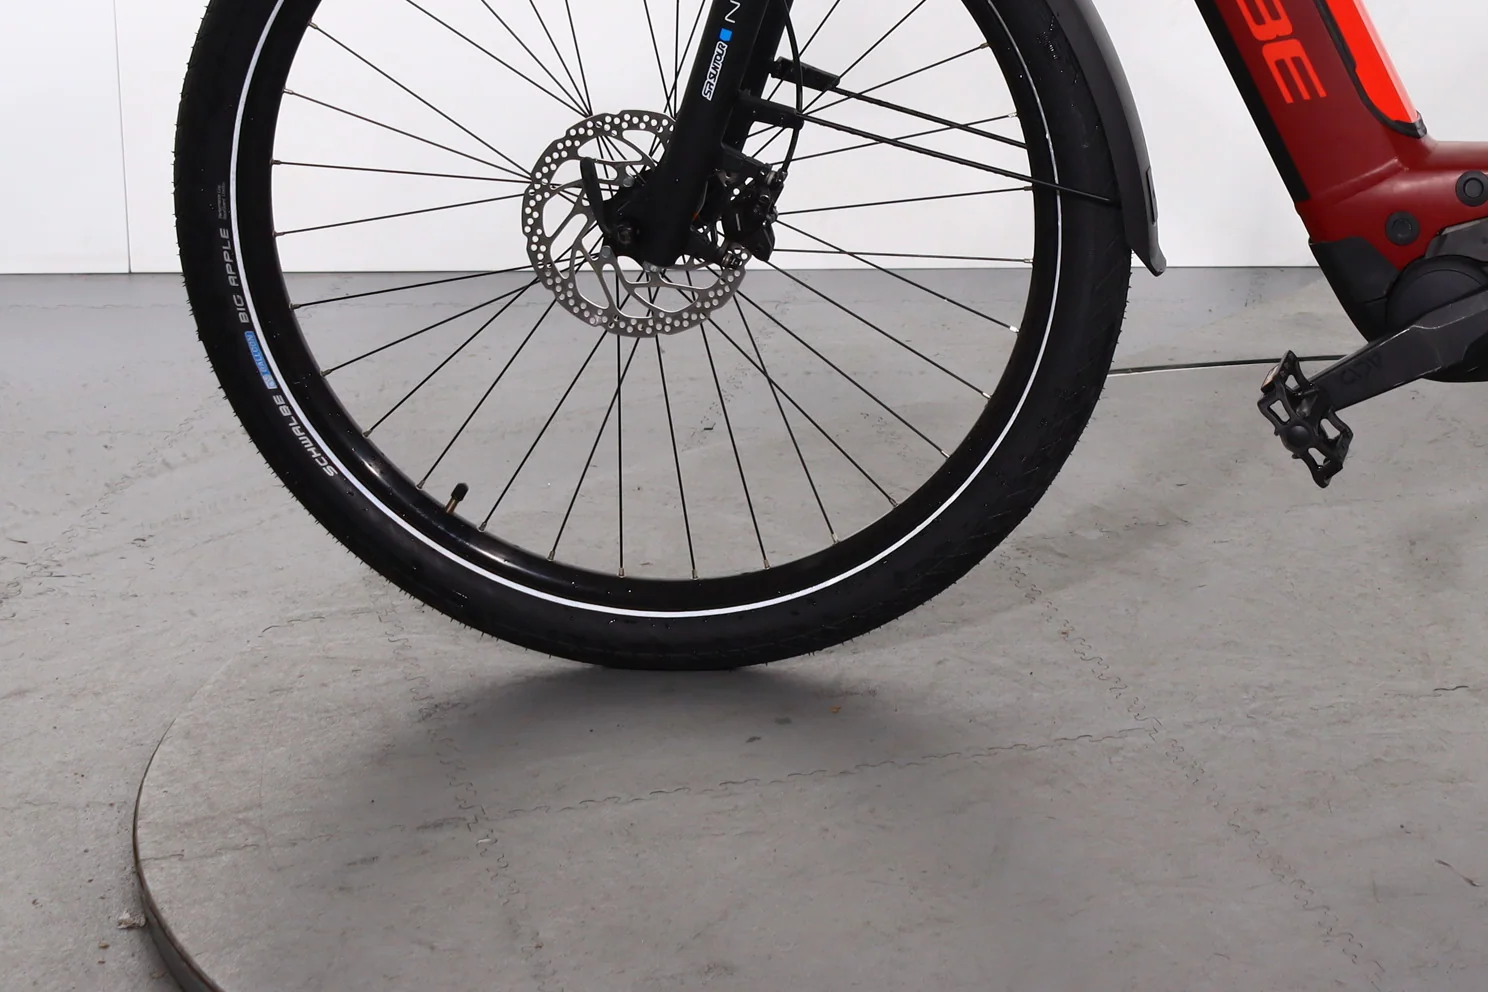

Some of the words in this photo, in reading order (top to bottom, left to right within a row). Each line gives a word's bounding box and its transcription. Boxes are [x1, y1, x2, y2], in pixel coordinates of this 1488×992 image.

[708, 40, 728, 82] SUNTOUR
[219, 227, 240, 287] APPLE
[232, 294, 249, 324] BIG
[273, 394, 338, 477] SCHWALBE
